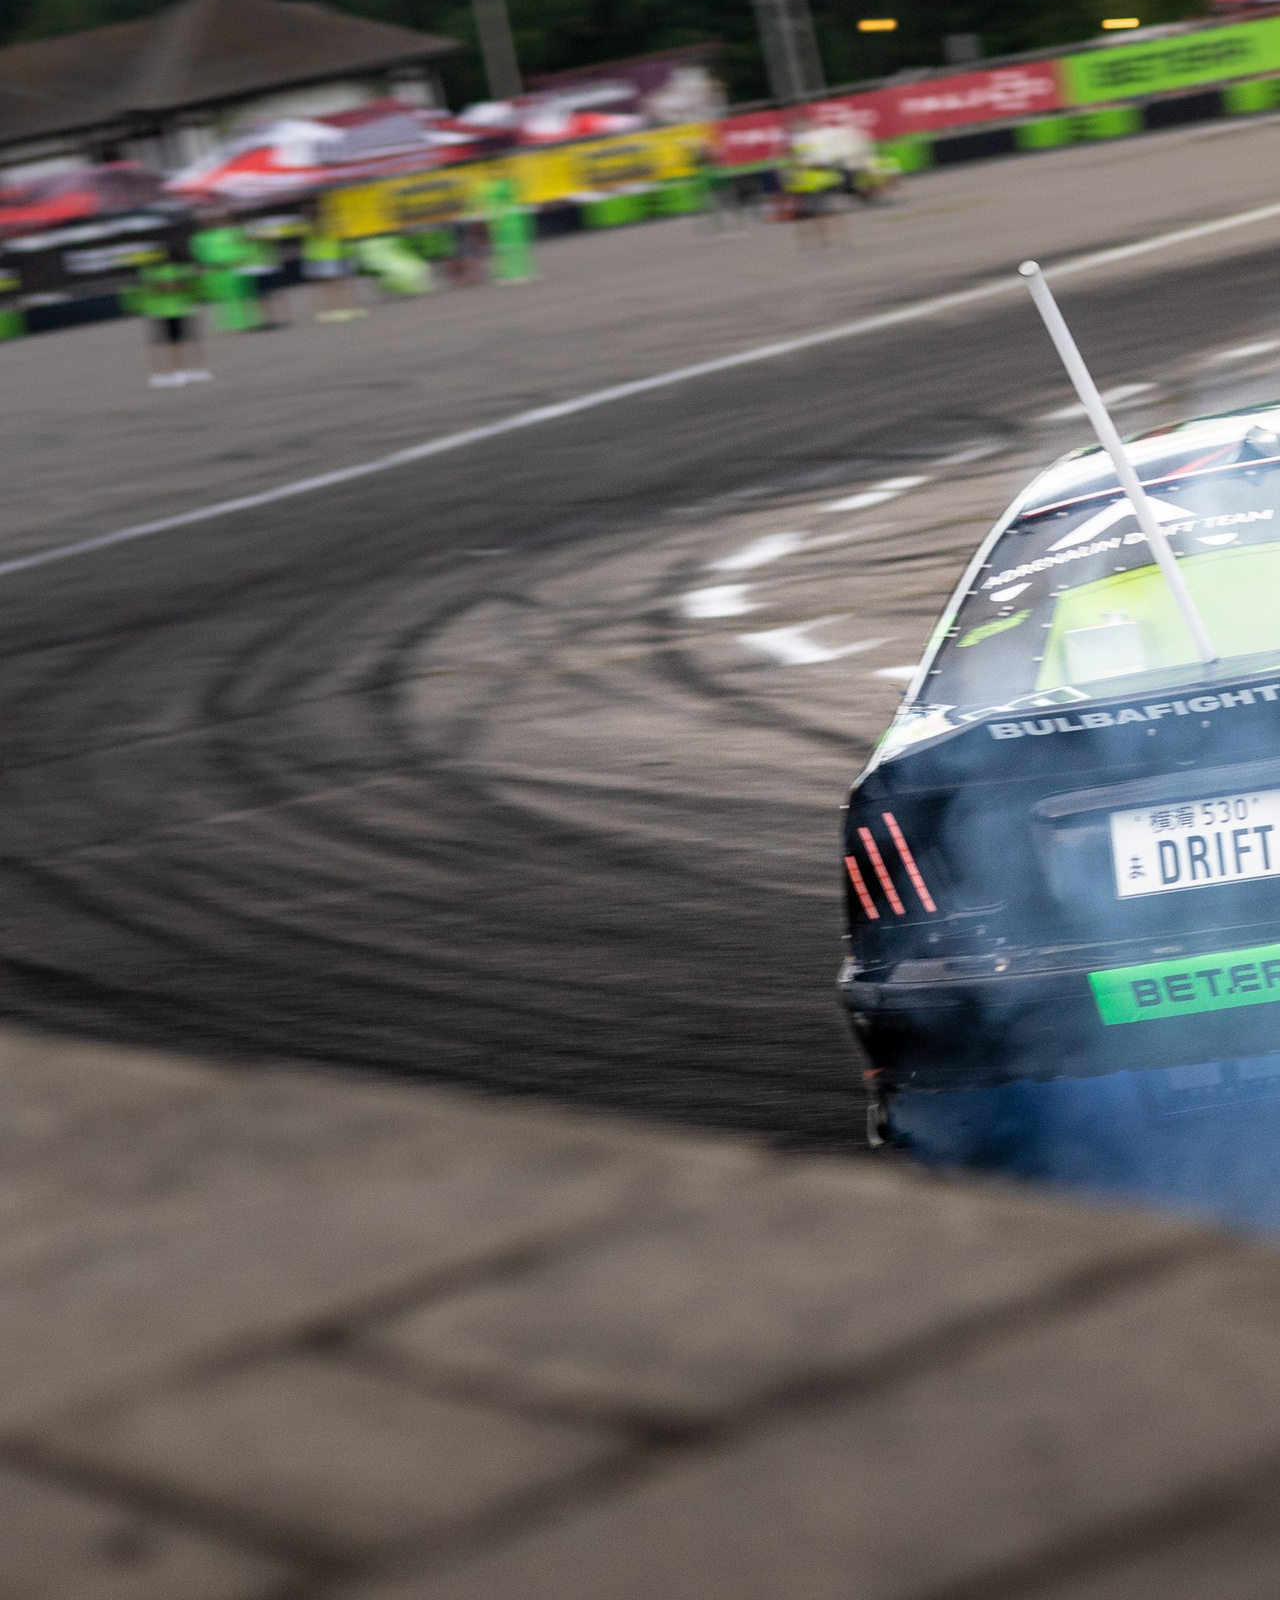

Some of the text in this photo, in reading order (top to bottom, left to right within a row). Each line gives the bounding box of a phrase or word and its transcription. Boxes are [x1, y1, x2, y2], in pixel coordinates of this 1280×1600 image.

[1201, 508, 1275, 529] TEAM
[1201, 798, 1249, 826] 530
[1157, 824, 1274, 885] DRIFT
